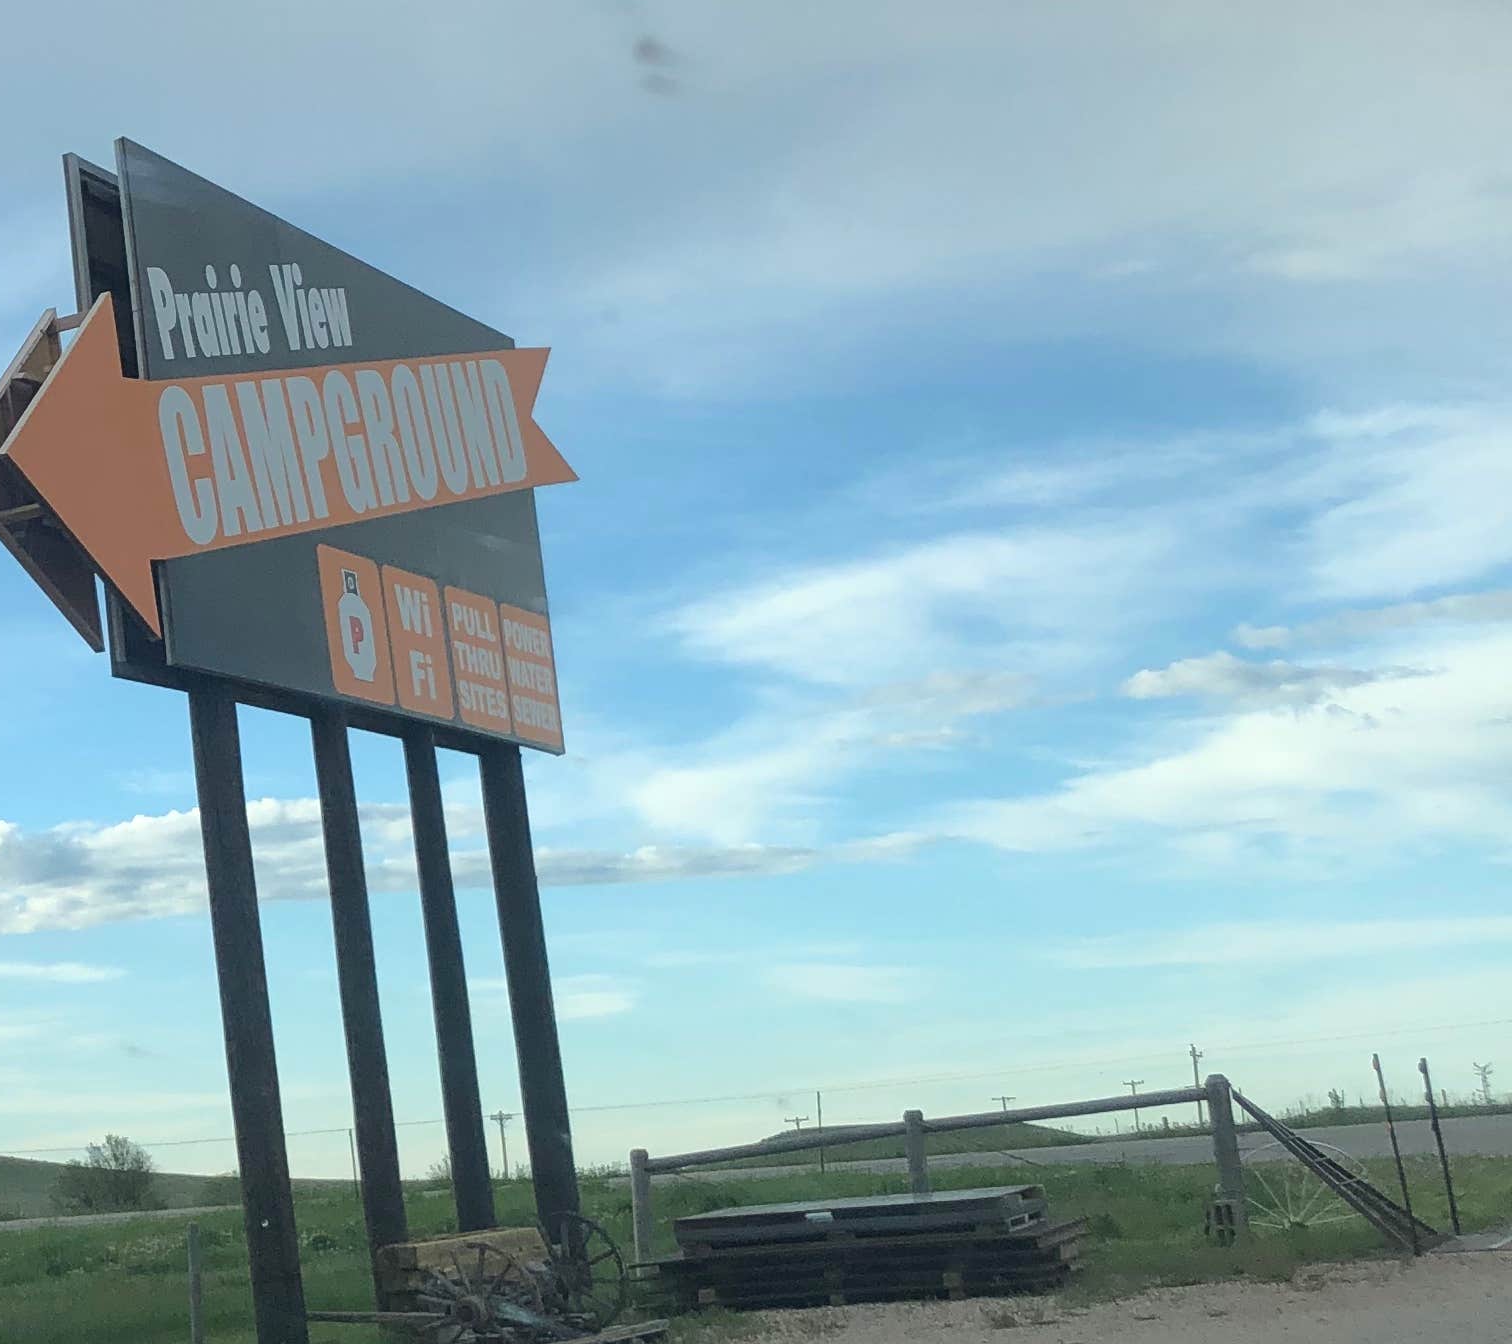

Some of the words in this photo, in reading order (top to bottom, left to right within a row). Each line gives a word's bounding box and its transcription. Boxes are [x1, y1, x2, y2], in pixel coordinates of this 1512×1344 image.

[146, 264, 271, 360] Prairie
[269, 262, 353, 350] View
[157, 359, 528, 545] CAMPGROUND
[394, 583, 433, 638] Wi
[451, 602, 496, 642] PULL
[349, 615, 365, 655] P
[503, 618, 550, 660] POWER
[409, 649, 437, 701] Fi
[454, 640, 502, 680] THRU
[508, 658, 555, 696] WATER
[459, 679, 508, 719] SITES
[512, 694, 558, 733] SEWER
